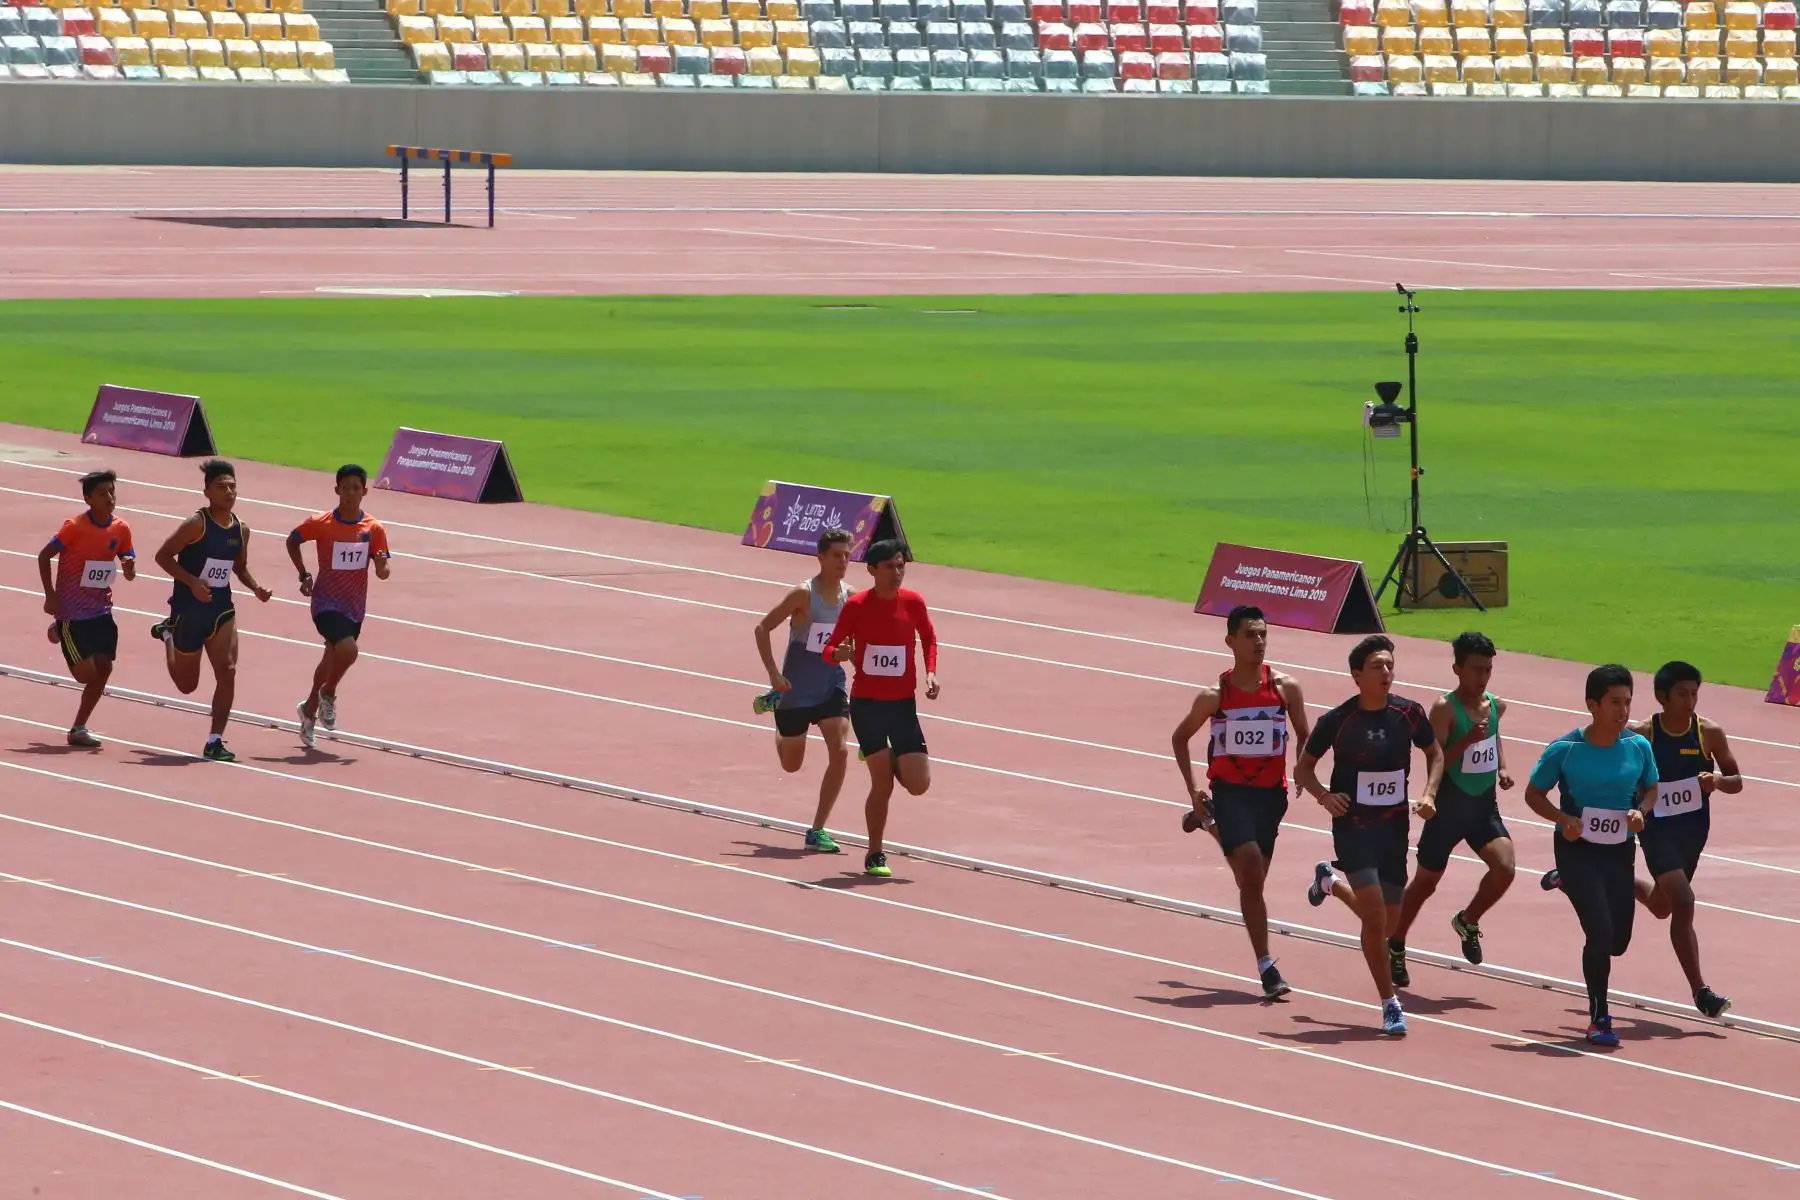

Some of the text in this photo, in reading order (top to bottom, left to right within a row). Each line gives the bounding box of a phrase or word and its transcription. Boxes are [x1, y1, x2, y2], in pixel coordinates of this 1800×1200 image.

[408, 443, 428, 457] Juegos
[427, 447, 468, 462] Panamericanos
[396, 456, 448, 472] Parapanamericanos
[447, 463, 461, 474] Lima
[798, 516, 821, 532] 2019
[340, 550, 363, 563] 117
[88, 569, 112, 582] 097
[207, 567, 228, 580] 095
[1235, 562, 1323, 587] Juegos Panamericanos y
[1220, 575, 1328, 601] Parapanamericanos Lima 2019
[871, 654, 899, 668] 104
[1234, 731, 1265, 746] 032
[1472, 746, 1495, 764] 018
[1367, 781, 1397, 796] 105
[1661, 789, 1692, 807] 100
[1589, 817, 1620, 834] 960
